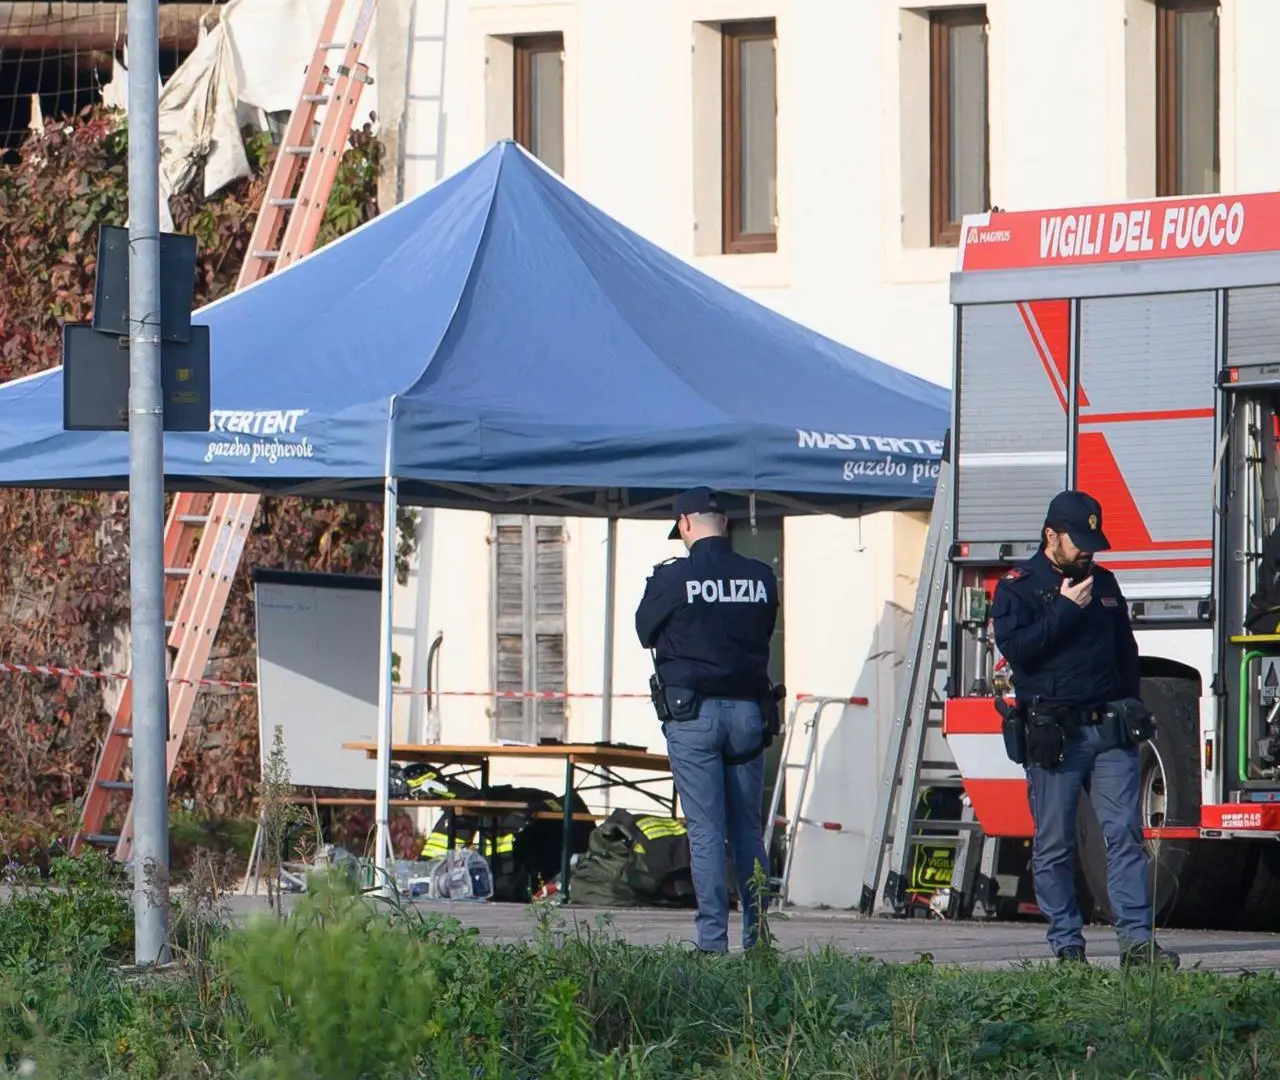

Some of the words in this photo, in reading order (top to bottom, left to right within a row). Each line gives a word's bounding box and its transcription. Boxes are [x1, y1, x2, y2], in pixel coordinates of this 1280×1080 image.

[1039, 213, 1105, 259] VIGILI
[1108, 209, 1153, 254] DEL
[1160, 202, 1245, 250] FUOCO
[209, 409, 305, 434] STERTENT
[204, 436, 250, 463] gazebo
[250, 436, 313, 464] pieghevole
[796, 428, 944, 454] MASTERTE
[842, 455, 906, 481] gazebo
[912, 460, 940, 484] pie
[685, 579, 768, 604] POLIZIA
